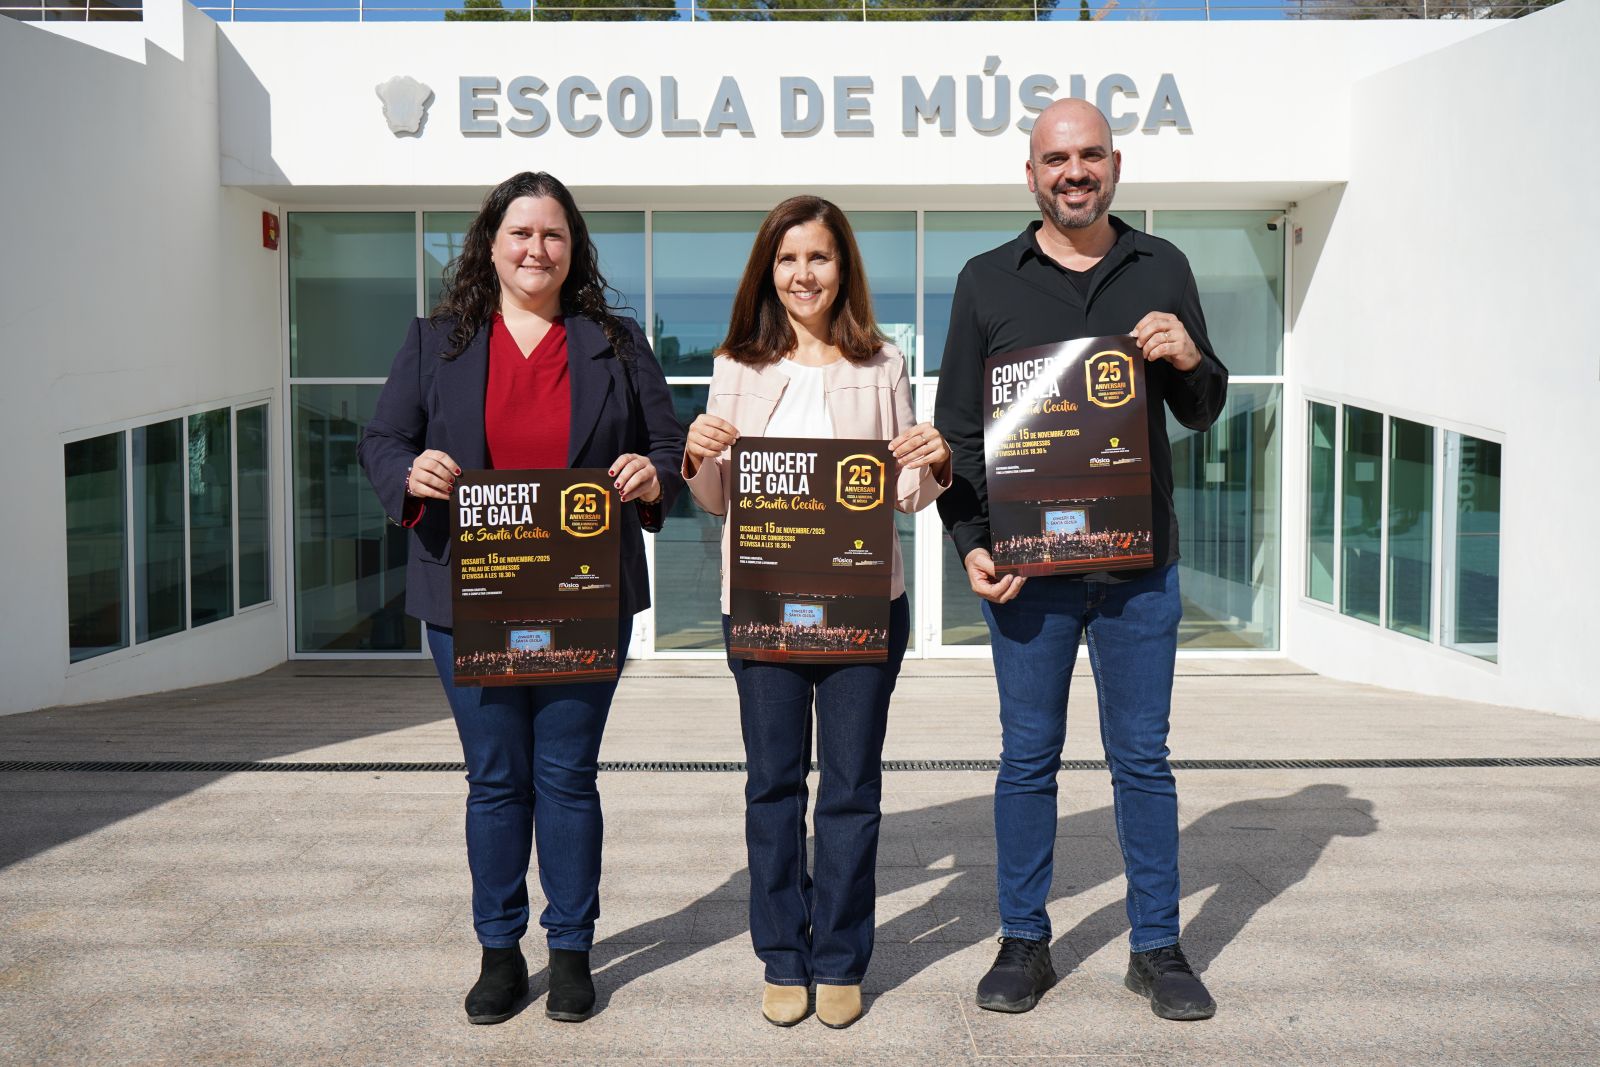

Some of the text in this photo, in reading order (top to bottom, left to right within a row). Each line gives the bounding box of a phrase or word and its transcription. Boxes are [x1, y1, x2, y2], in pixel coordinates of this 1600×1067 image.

[459, 75, 756, 138] ESCOLA
[779, 75, 874, 138] DE
[992, 357, 1063, 385] CONCER
[1097, 361, 1121, 382] 25
[992, 378, 1060, 405] DE GA
[1095, 382, 1126, 390] ANIVERSARI
[992, 407, 1004, 419] de
[1018, 428, 1029, 440] 15
[739, 451, 818, 474] CONCERT
[739, 473, 810, 495] DE GALA
[848, 465, 872, 486] 25
[458, 483, 541, 506] CONCERT
[573, 493, 597, 513] 25
[739, 496, 753, 509] de
[755, 495, 790, 510] Santa
[459, 505, 533, 528] DE GALA
[460, 530, 474, 542] de
[476, 527, 513, 542] Santa
[764, 521, 775, 533] 15
[776, 526, 782, 534] DE
[783, 526, 826, 535] NOVEMBRE/2025
[461, 553, 551, 565] DISSABTE 15 DE NOVEMBRE/2025
